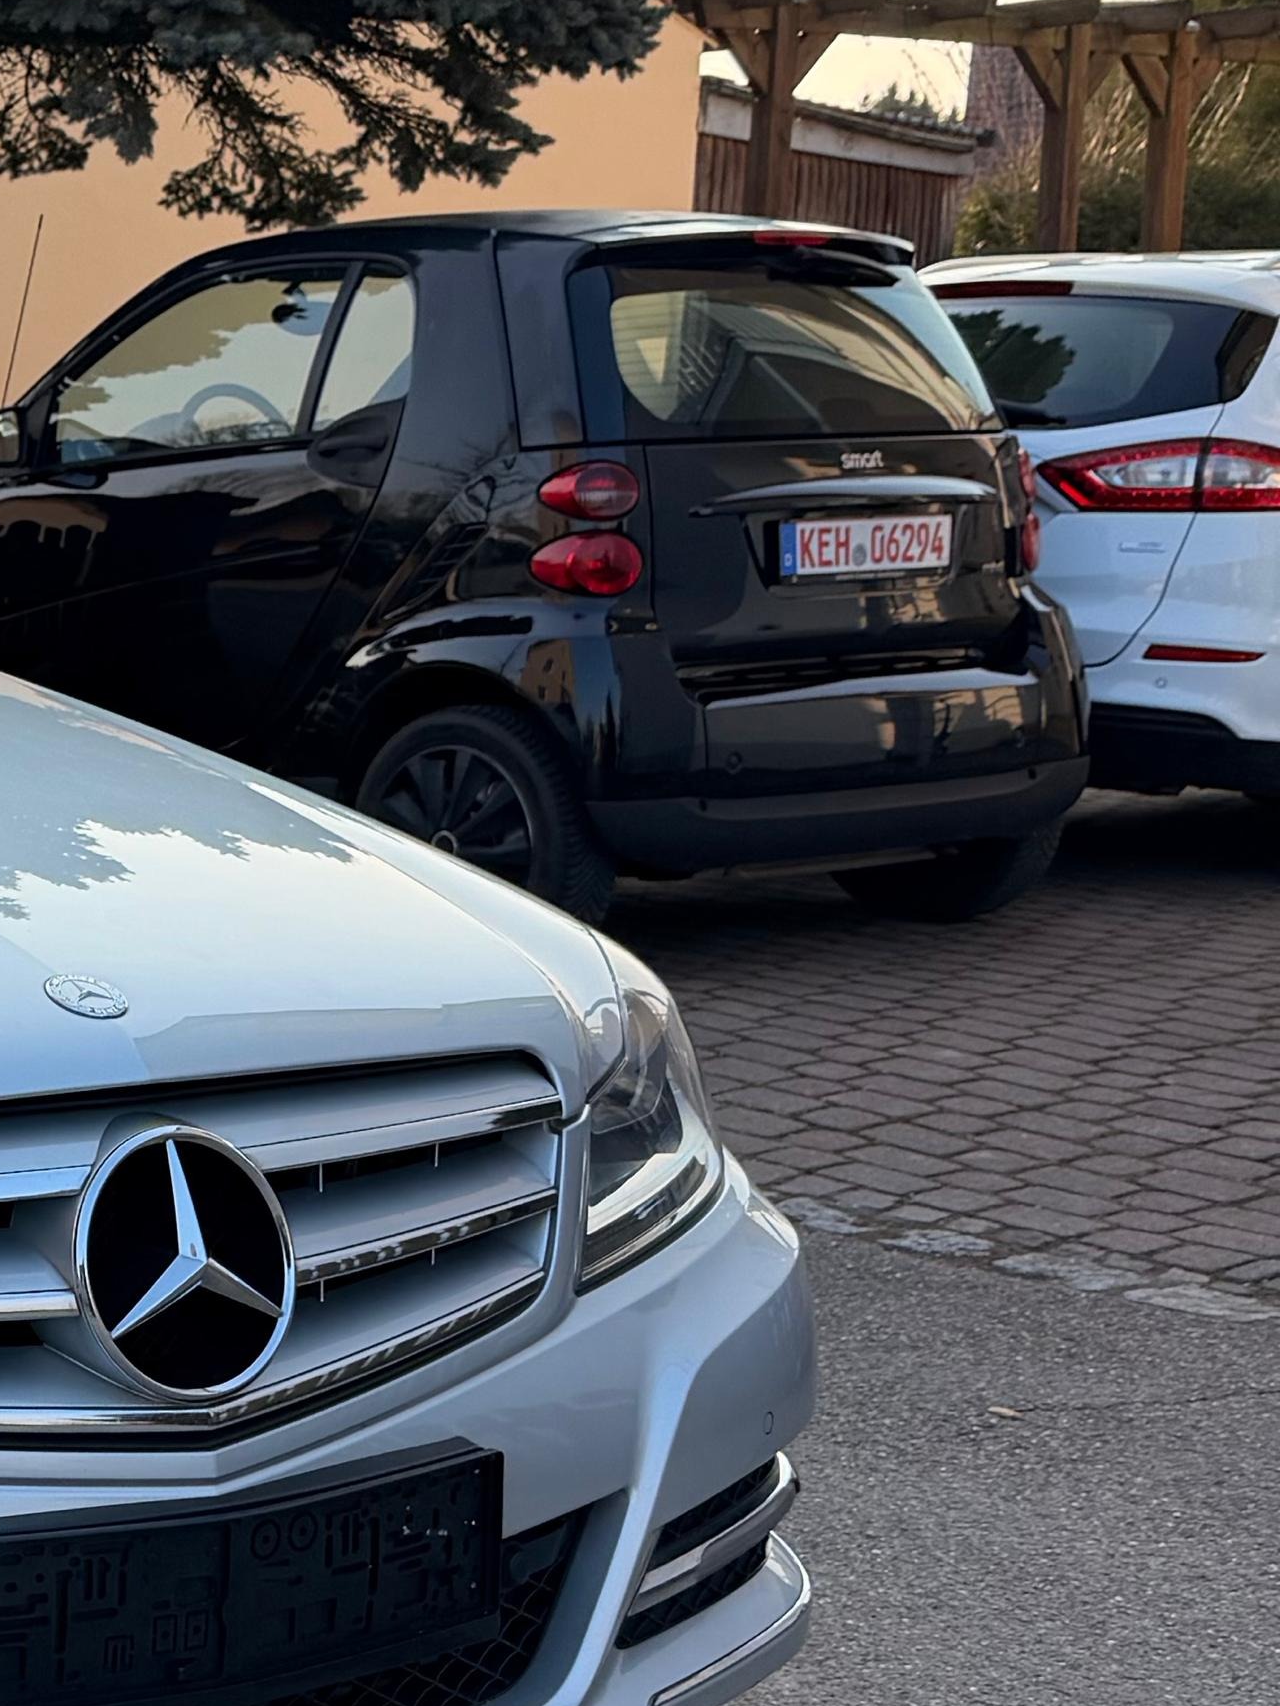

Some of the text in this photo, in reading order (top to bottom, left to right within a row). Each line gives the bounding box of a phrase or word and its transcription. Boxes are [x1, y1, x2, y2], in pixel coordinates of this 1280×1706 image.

[840, 449, 885, 469] smart
[799, 522, 945, 568] KEH 06294
